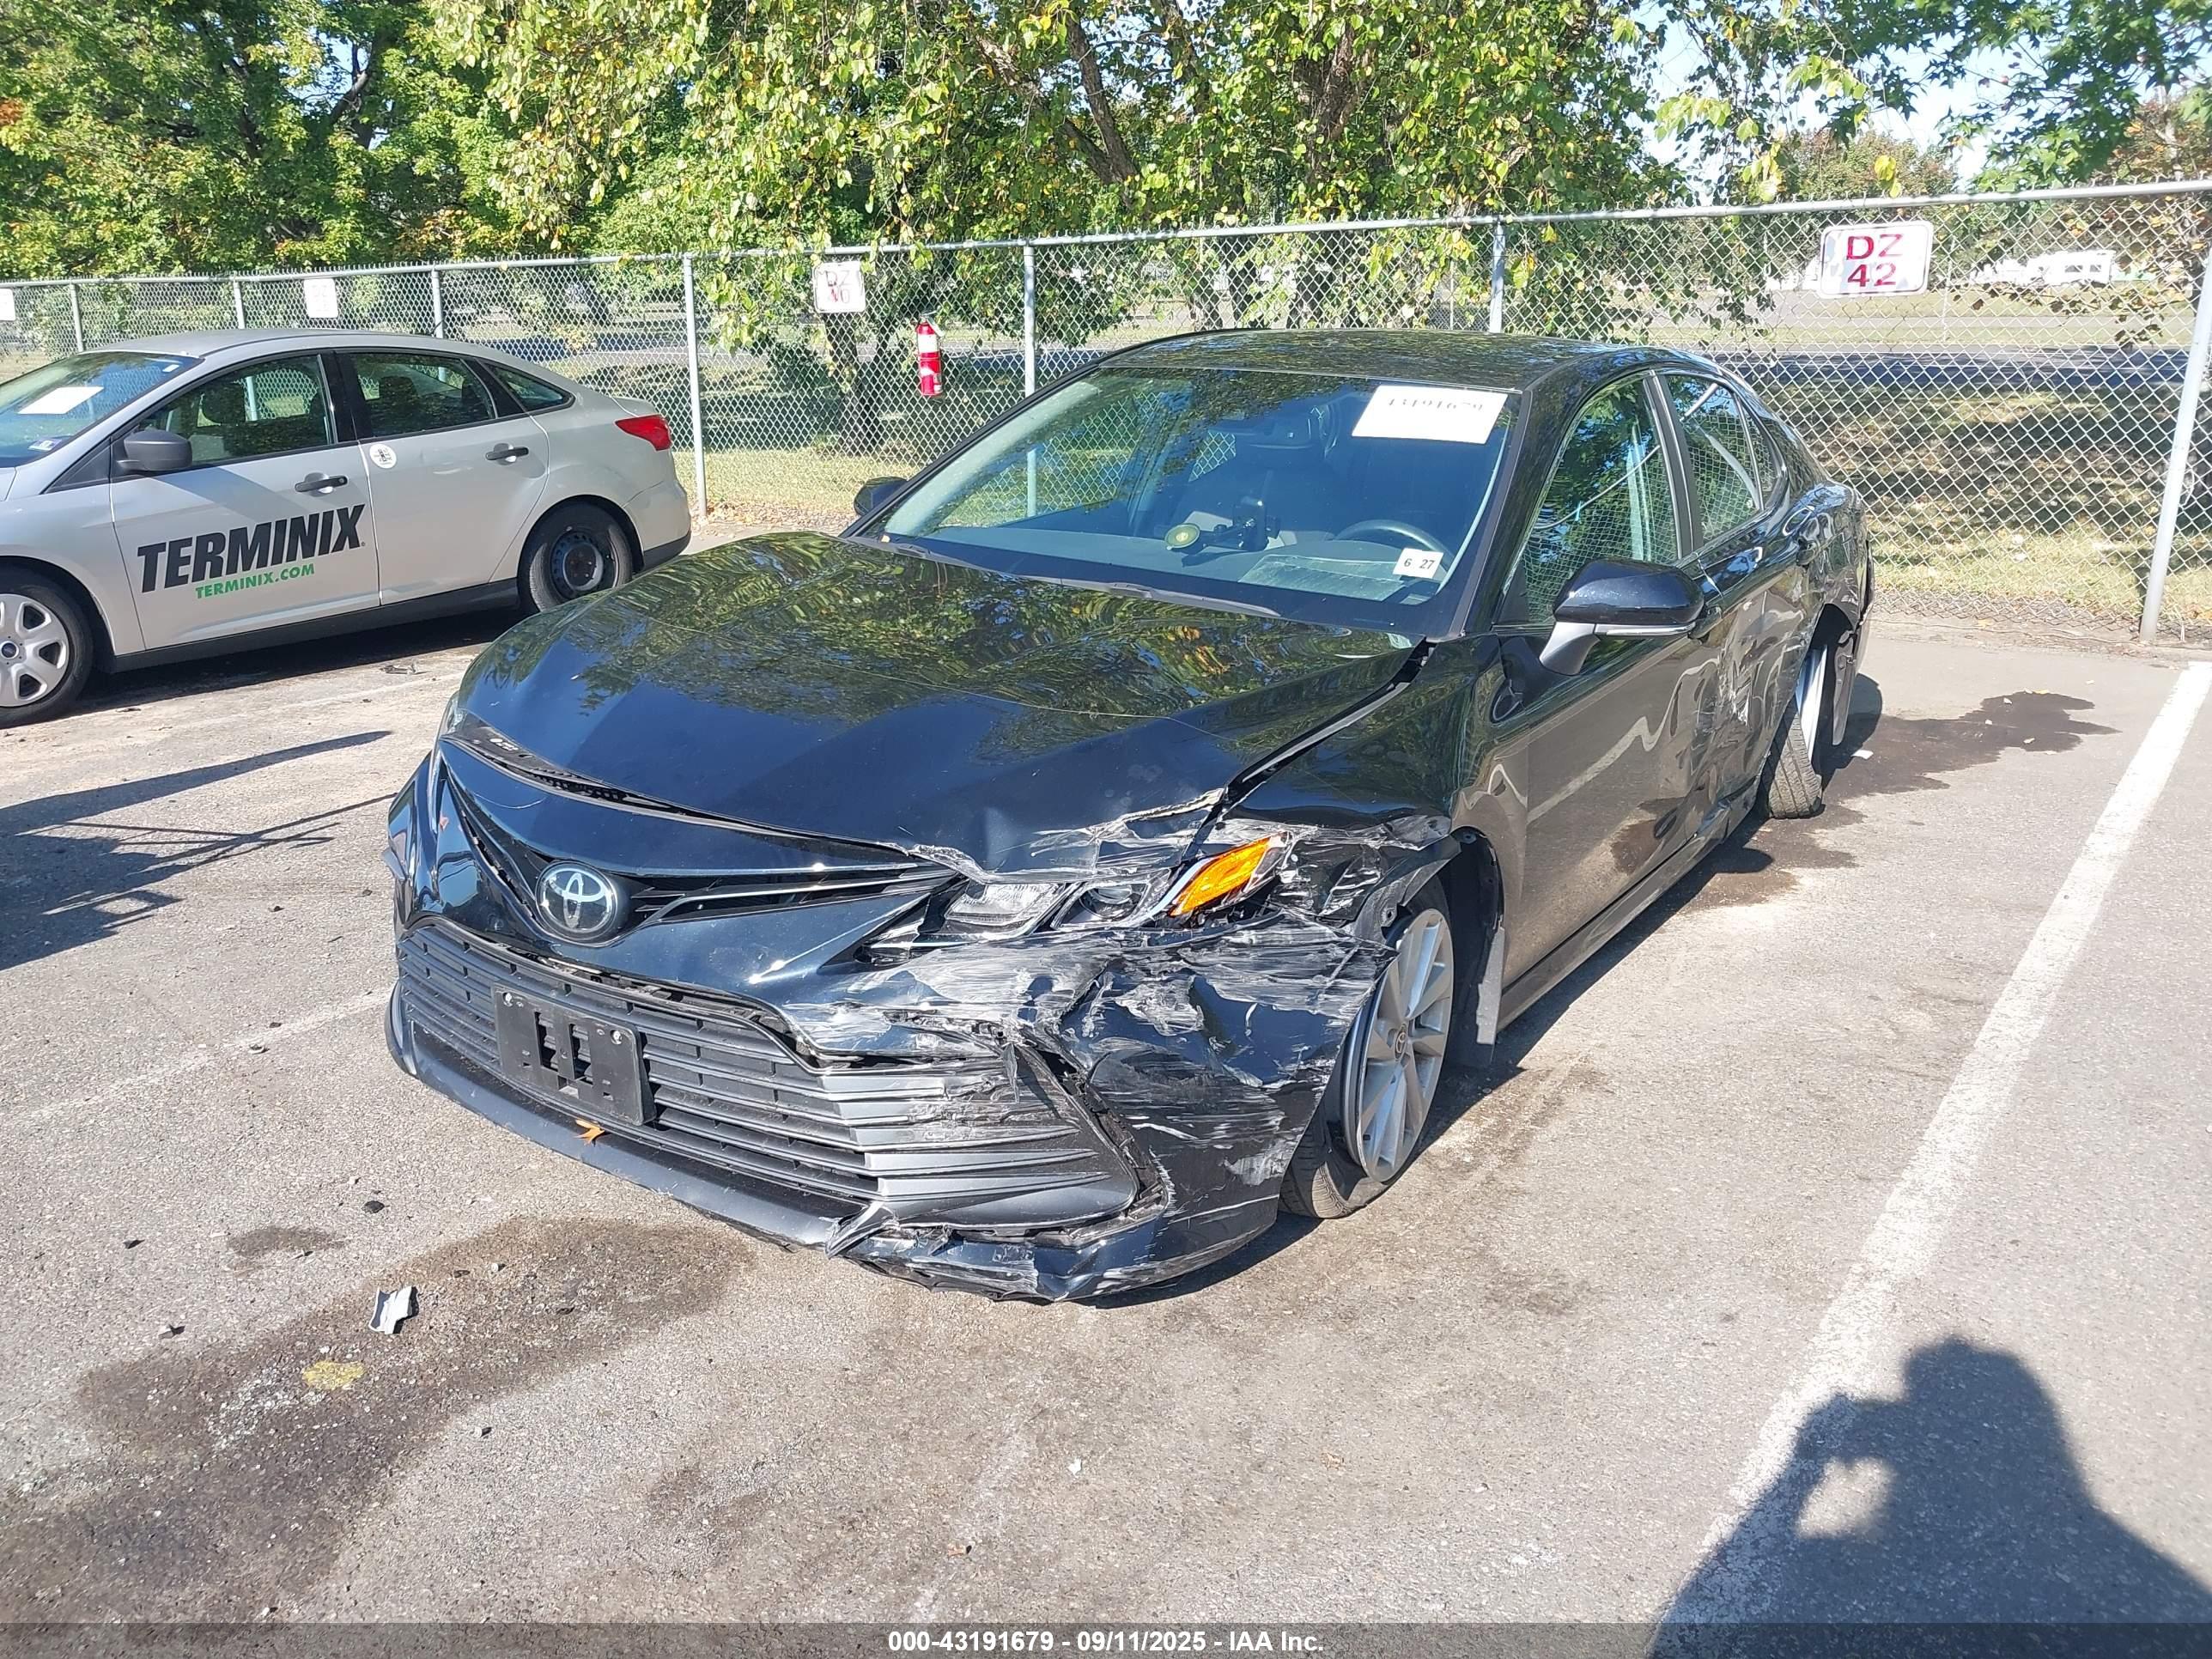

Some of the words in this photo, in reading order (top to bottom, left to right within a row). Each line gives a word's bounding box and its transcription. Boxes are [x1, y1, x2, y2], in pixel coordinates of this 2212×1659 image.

[1846, 234, 1903, 260] DZ
[1847, 262, 1897, 287] 42
[137, 503, 365, 593] TERMINIX
[1403, 558, 1413, 568] 6
[1419, 559, 1436, 569] 27
[195, 563, 315, 599] TERMINIX.COM
